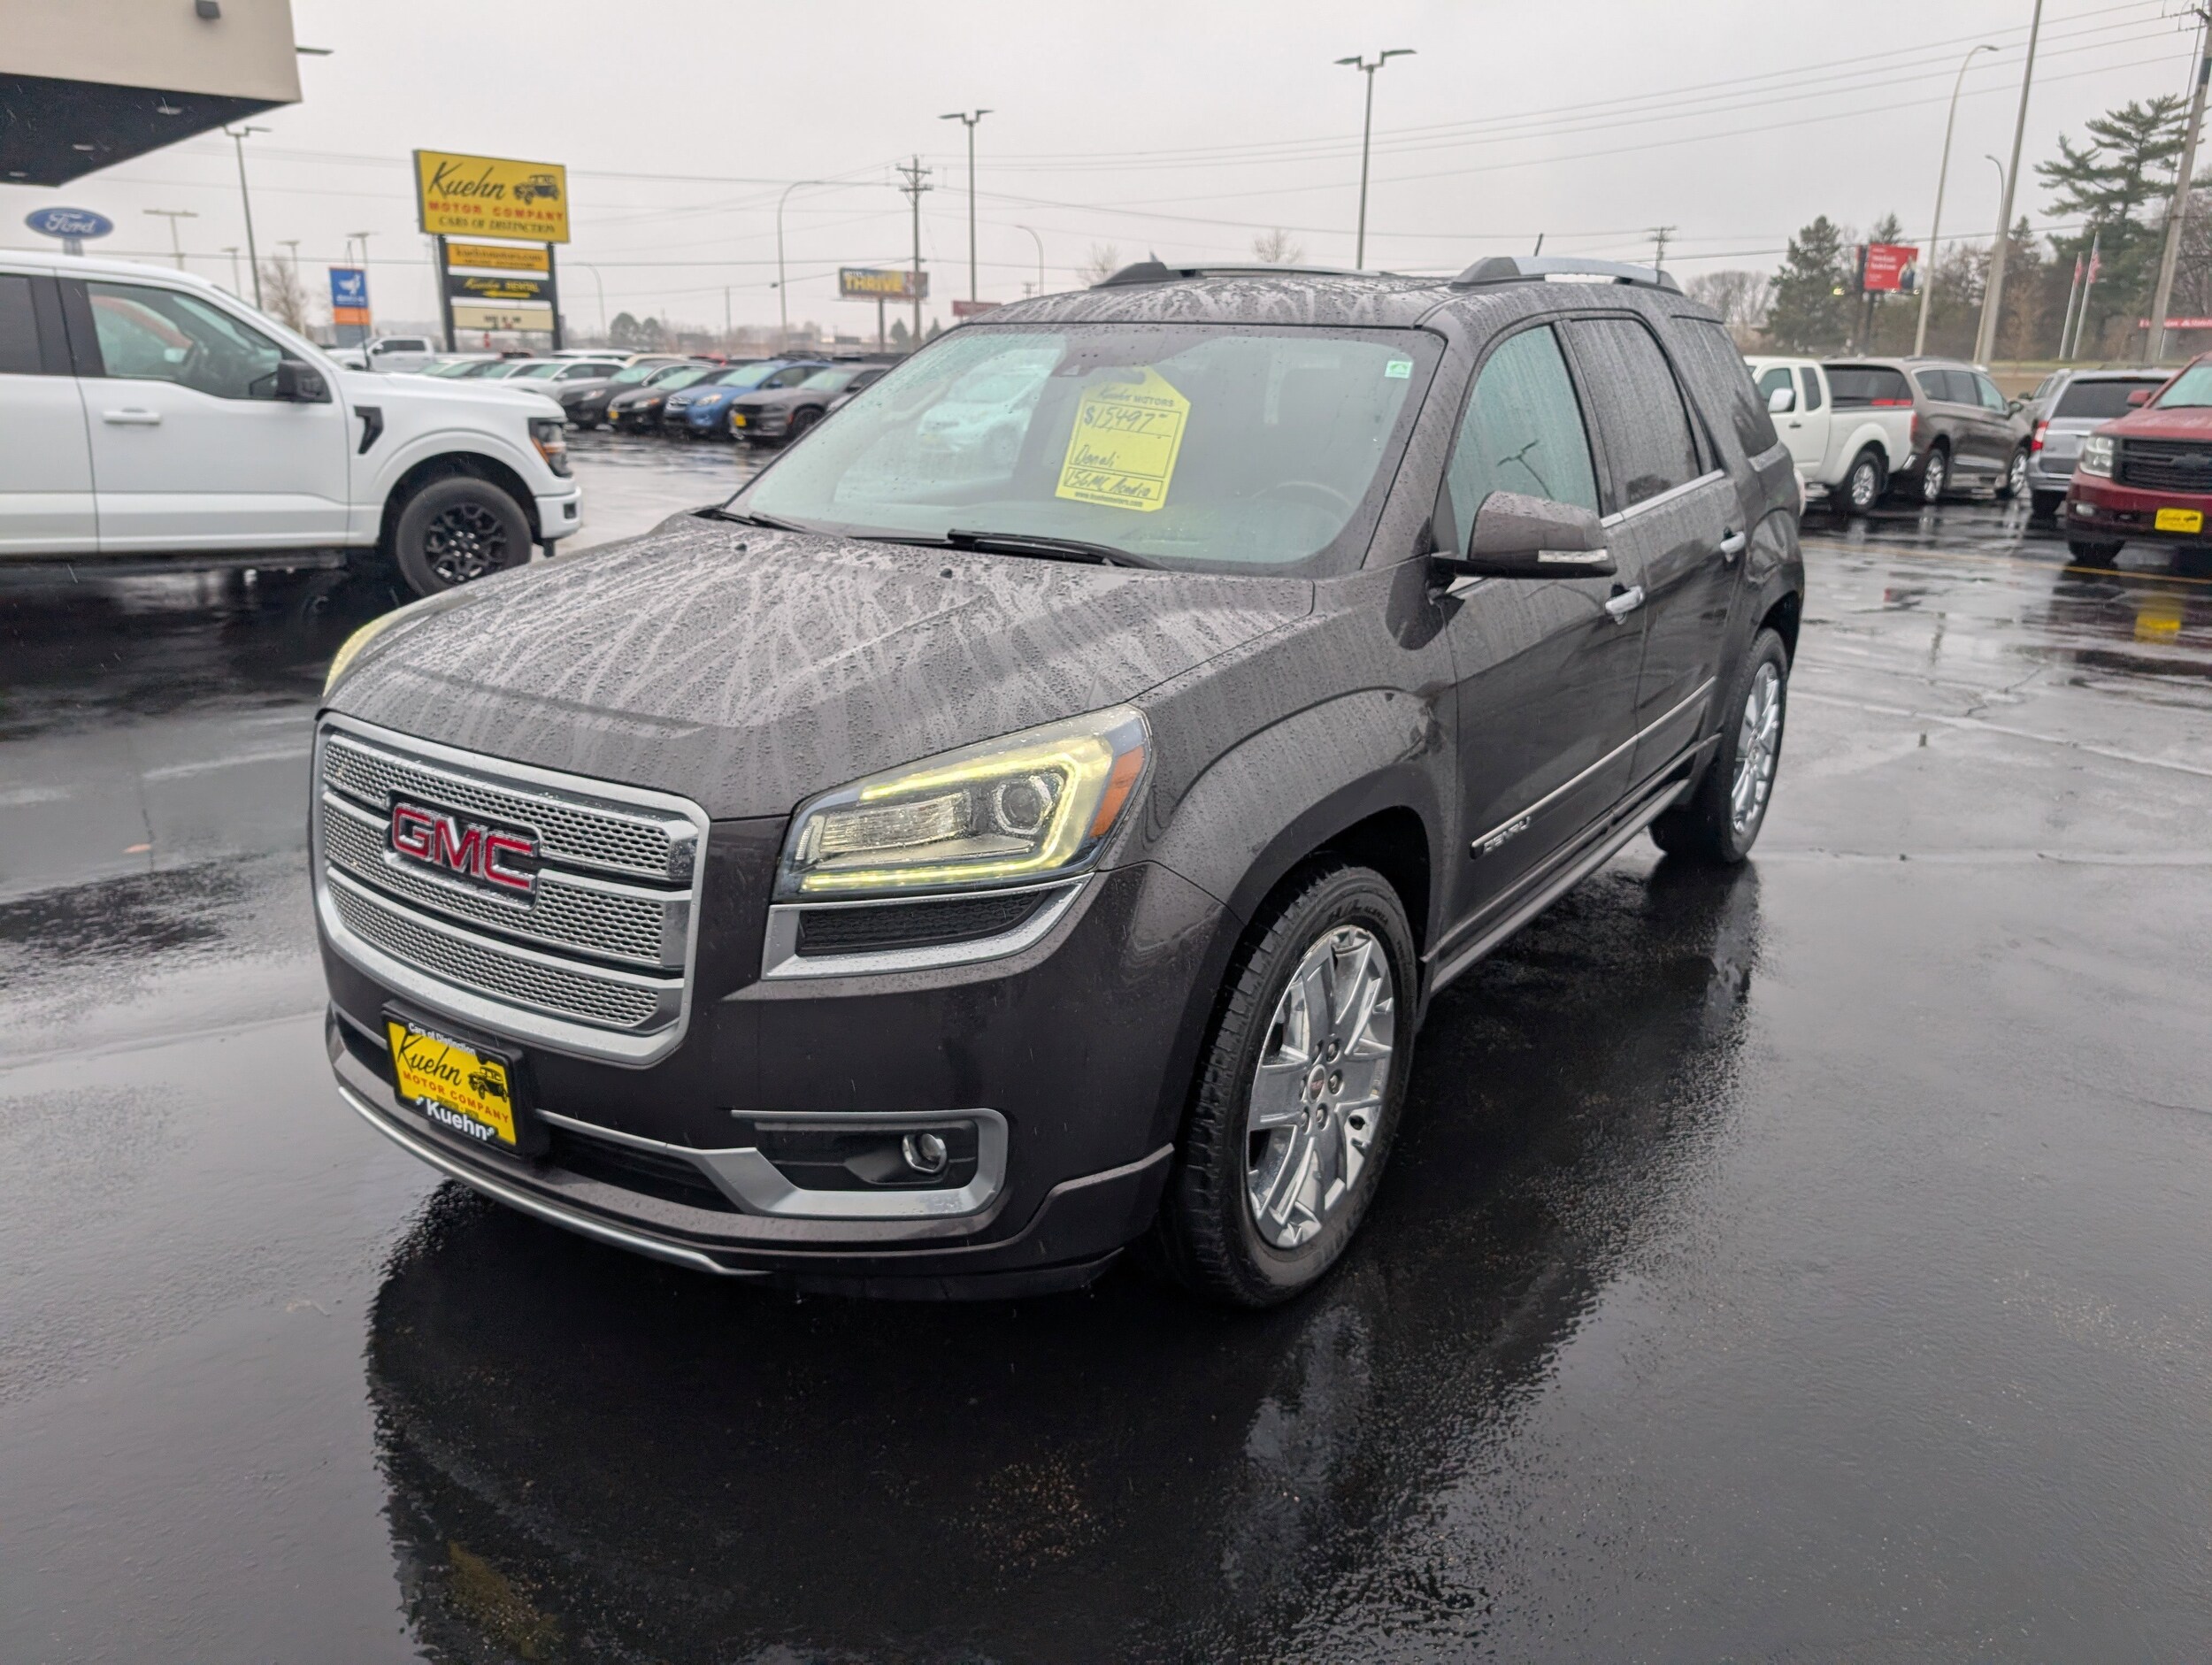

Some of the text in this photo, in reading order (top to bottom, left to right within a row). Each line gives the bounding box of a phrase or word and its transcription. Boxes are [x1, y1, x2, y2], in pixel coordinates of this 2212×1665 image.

[428, 160, 506, 201] Kuehn
[44, 212, 96, 234] Ford
[428, 201, 564, 221] MOTOR COMPANY
[438, 217, 469, 228] CARS
[1133, 395, 1175, 408] MOTORS
[392, 802, 538, 894] GMC
[408, 1022, 476, 1056] Cars of Distinction
[397, 1032, 463, 1086] Kuehn
[403, 1070, 446, 1095] MOTOR
[449, 1090, 510, 1124] COMPANY
[426, 1098, 488, 1141] Kuehn
